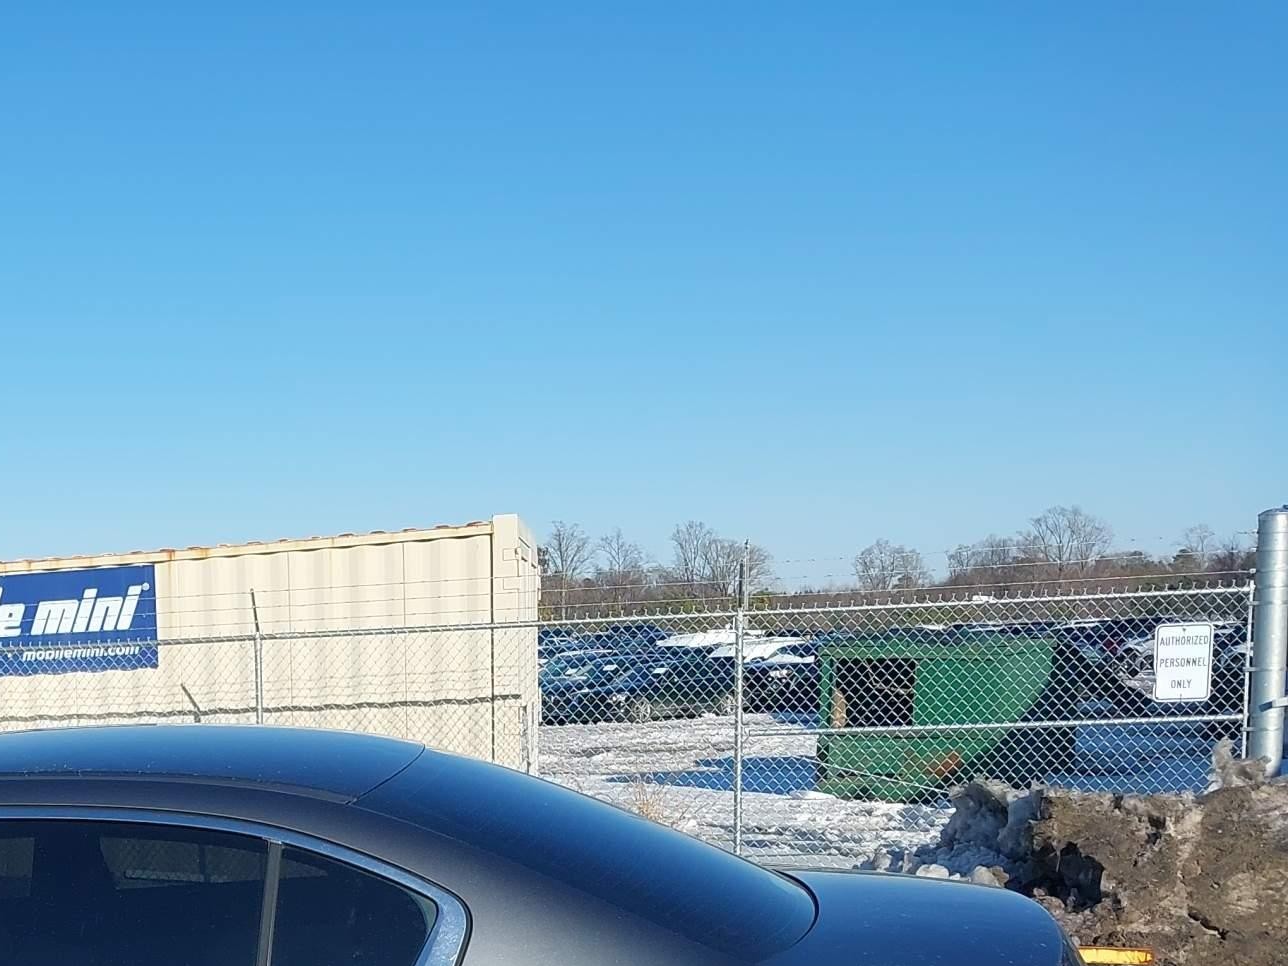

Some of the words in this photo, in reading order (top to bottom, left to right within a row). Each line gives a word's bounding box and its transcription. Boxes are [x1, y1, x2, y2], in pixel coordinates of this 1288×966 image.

[30, 585, 143, 636] mini
[1160, 636, 1208, 646] AUTHORIZED
[1160, 657, 1207, 667] PERSONNEL
[1170, 679, 1192, 689] ONLY
